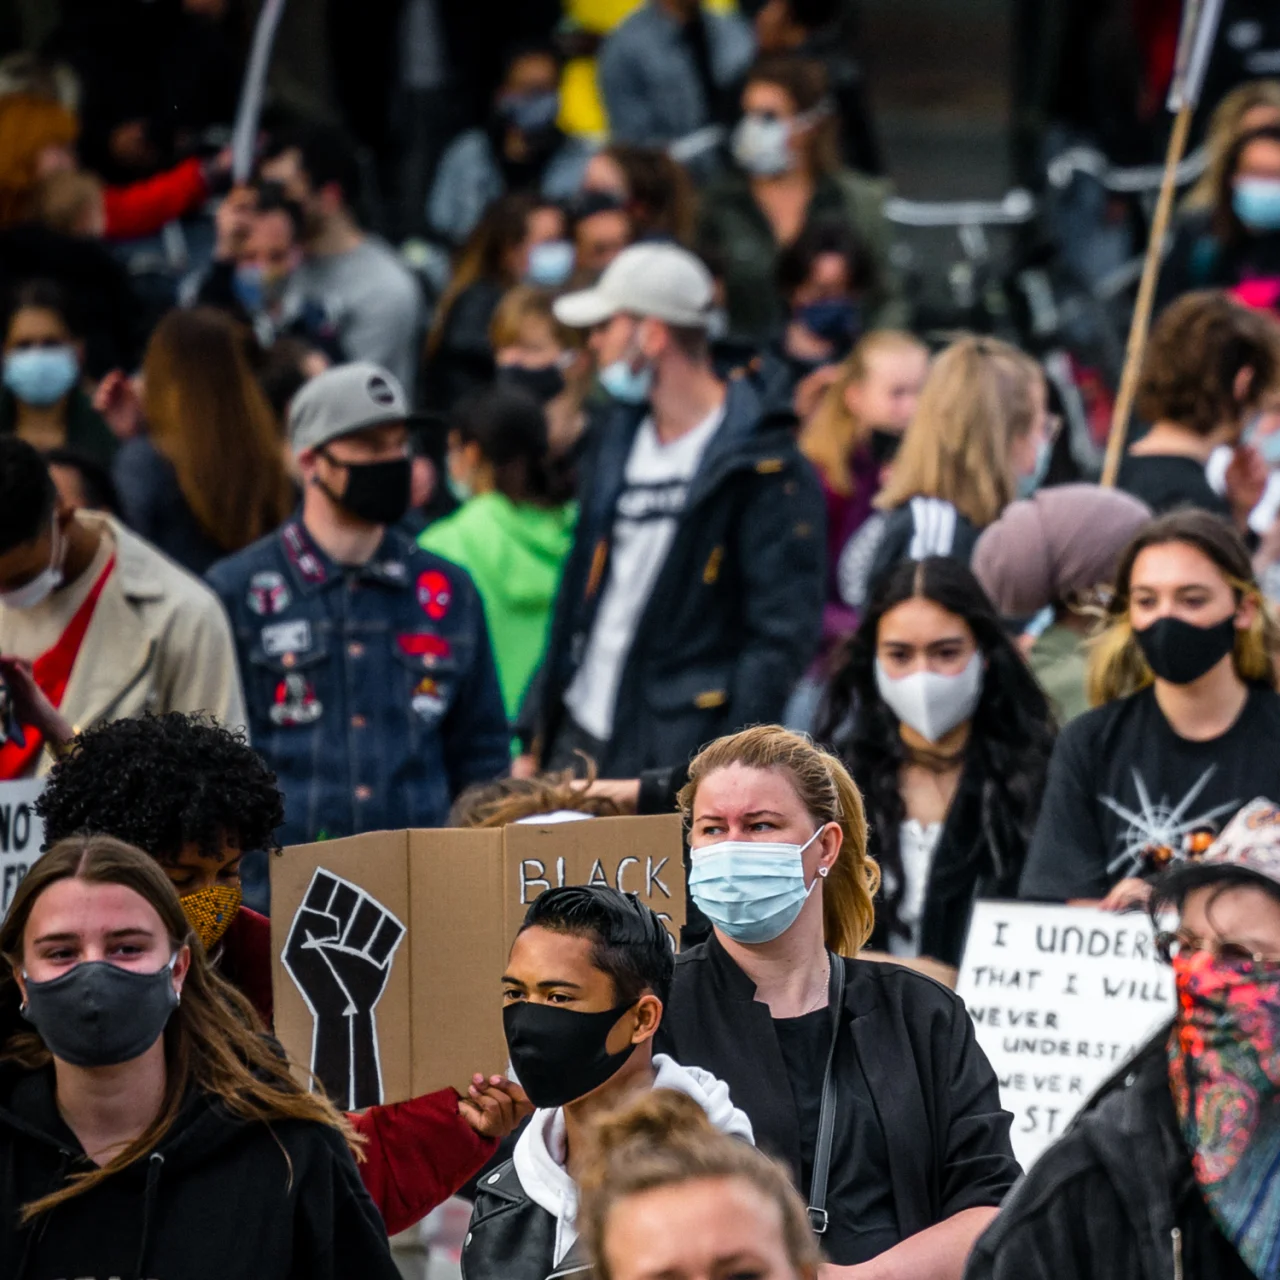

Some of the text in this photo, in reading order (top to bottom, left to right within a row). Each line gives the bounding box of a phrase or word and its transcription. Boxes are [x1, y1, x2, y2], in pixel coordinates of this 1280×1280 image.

[992, 921, 1163, 964] I UNDER
[972, 965, 1170, 1003] THAT I WILL
[1020, 1104, 1061, 1135] ST
